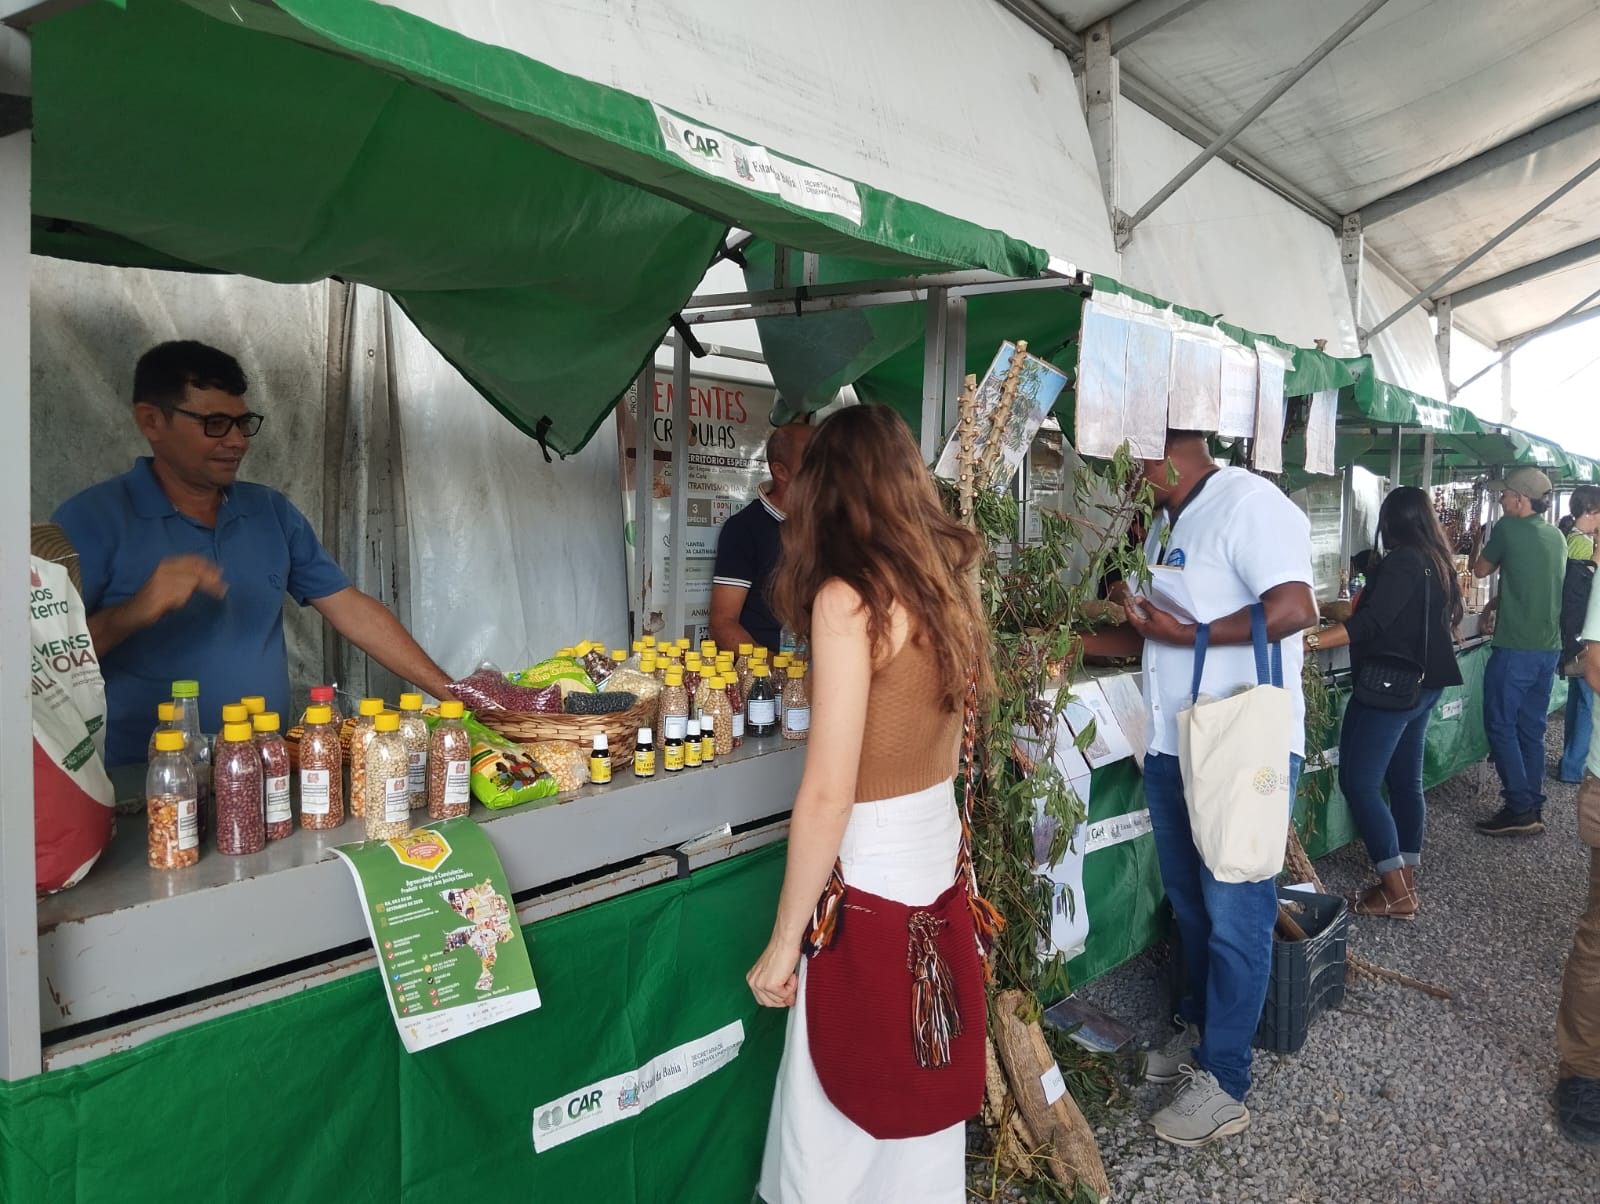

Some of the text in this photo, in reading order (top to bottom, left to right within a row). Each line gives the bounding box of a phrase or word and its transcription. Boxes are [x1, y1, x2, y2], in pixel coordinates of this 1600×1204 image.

[684, 130, 722, 158] CAR
[692, 503, 698, 514] 3
[662, 1063, 682, 1078] Bahia
[567, 1089, 604, 1120] CAR
